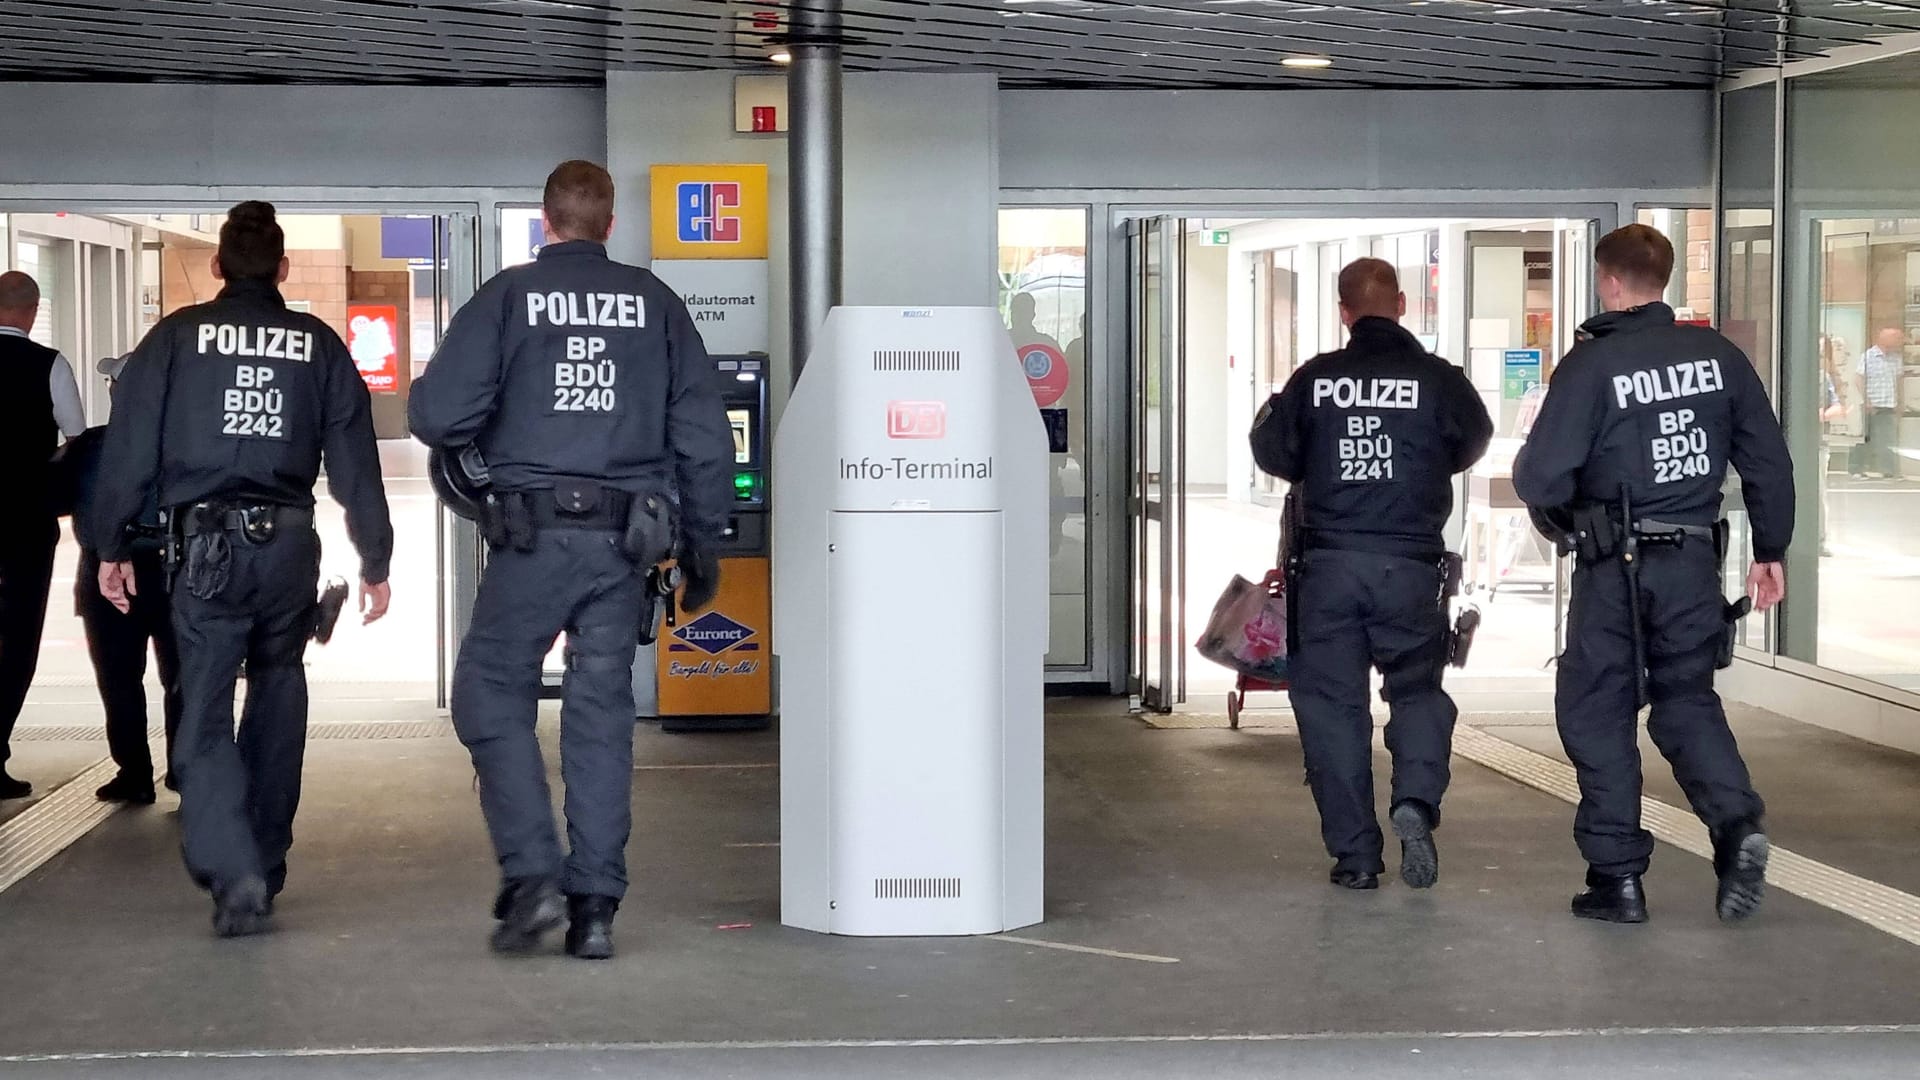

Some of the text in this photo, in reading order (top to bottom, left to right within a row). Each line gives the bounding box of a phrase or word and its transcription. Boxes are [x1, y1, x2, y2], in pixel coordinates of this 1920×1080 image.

[525, 290, 647, 330] POLIZEI
[683, 293, 756, 306] ldautomat
[695, 310, 726, 322] ATM
[196, 323, 314, 362] POLIZEI
[565, 336, 607, 361] BP
[234, 365, 275, 389] BP
[554, 359, 617, 388] BDÜ
[1612, 358, 1724, 410] POLIZEI
[223, 388, 284, 415] BDÜ
[553, 387, 616, 413] 2240
[1312, 376, 1420, 410] POLIZEI
[221, 412, 283, 438] 2242
[894, 407, 939, 434] DB
[1346, 415, 1383, 437] BP
[1658, 408, 1695, 436] BP
[1338, 432, 1394, 460] BDÜ
[1651, 426, 1708, 461] BDÜ
[839, 456, 993, 480] Info-Terminal
[1339, 458, 1394, 482] 2241
[1653, 453, 1711, 484] 2240
[684, 626, 742, 641] Euronet
[669, 660, 759, 680] Bargeld für alle!
